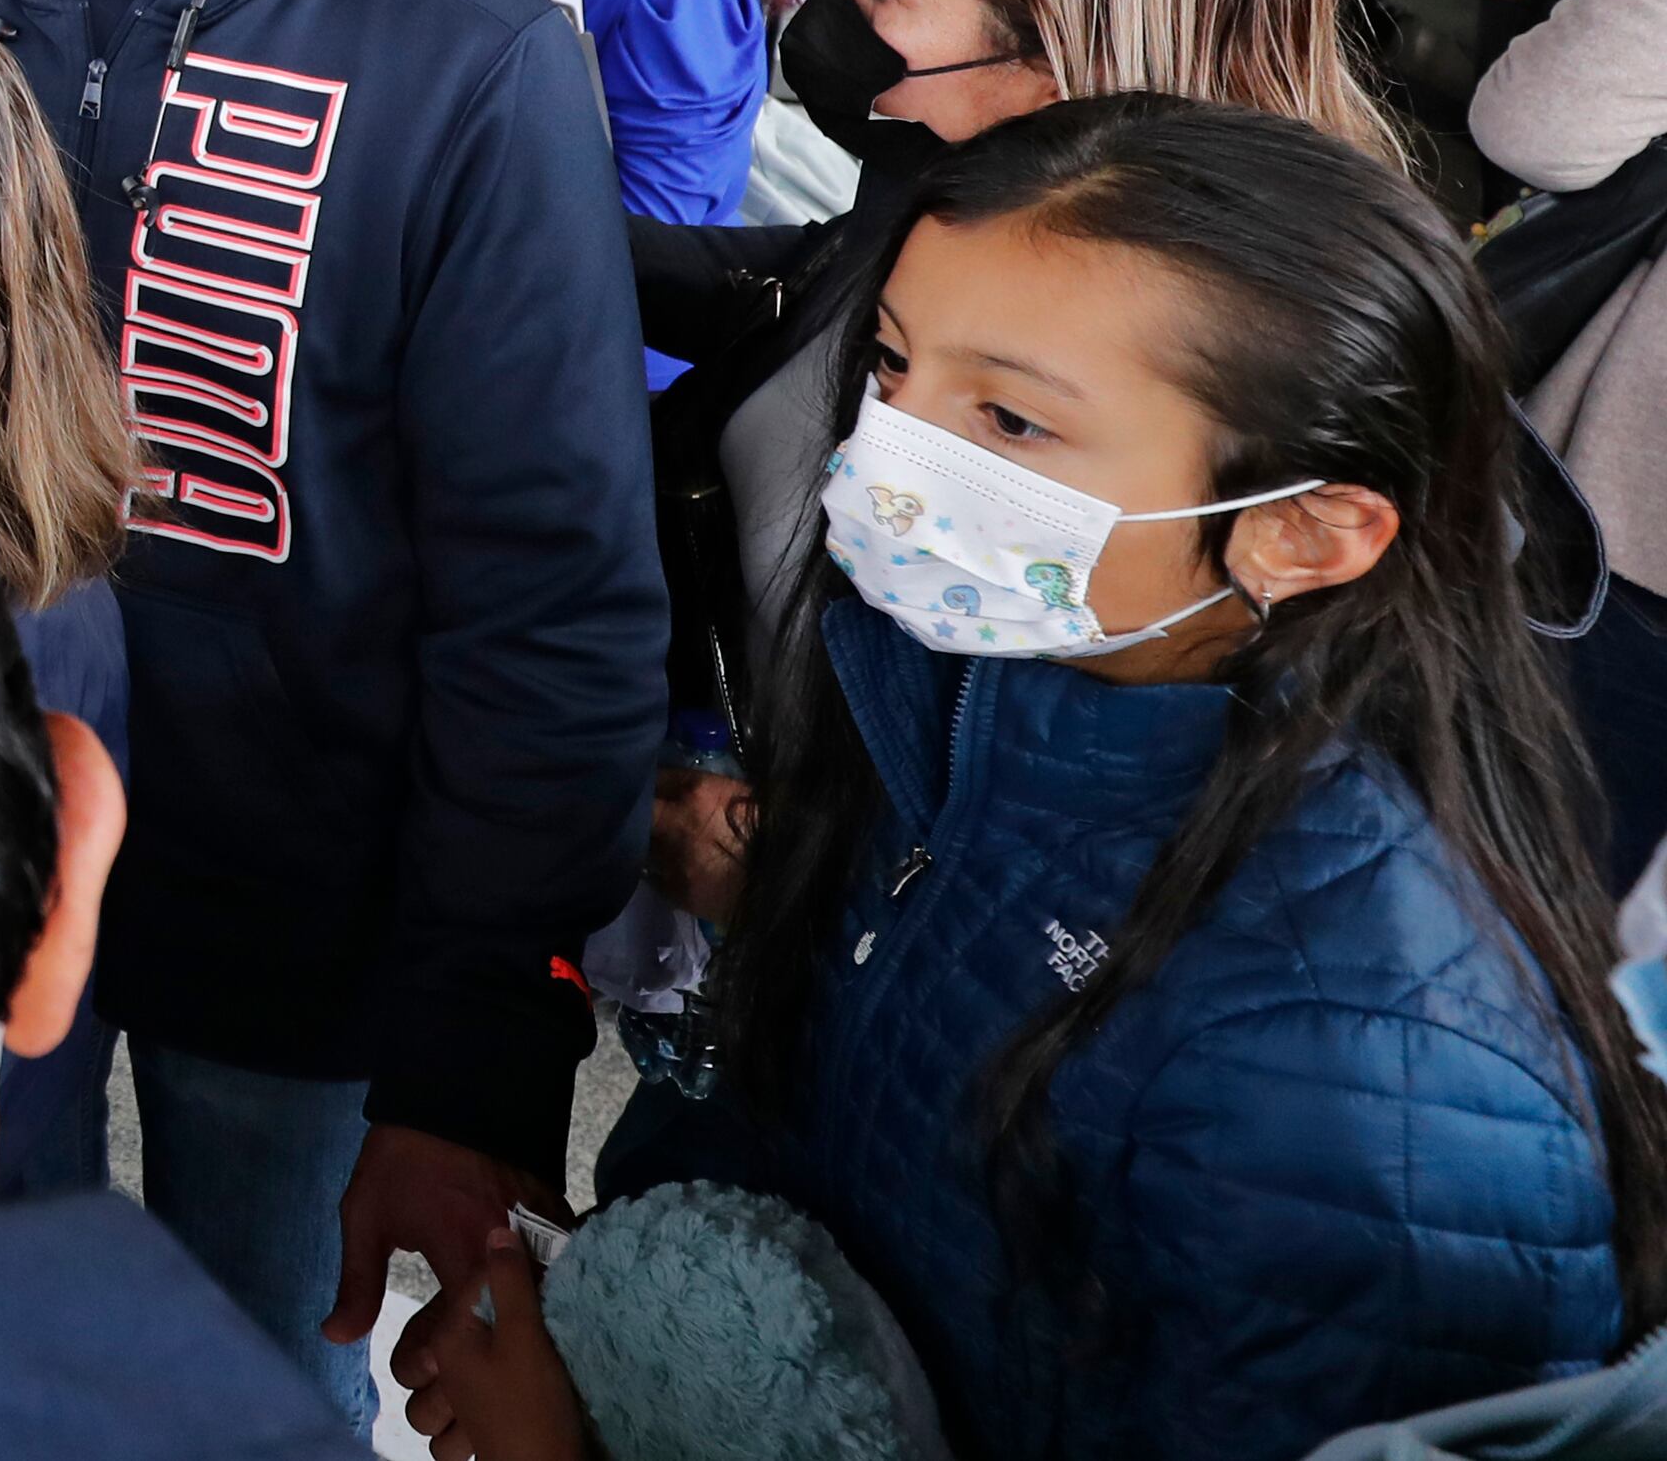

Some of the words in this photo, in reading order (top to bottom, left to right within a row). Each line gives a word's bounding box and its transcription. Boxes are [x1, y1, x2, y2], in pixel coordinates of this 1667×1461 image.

[117, 51, 348, 564] PUMA
[1044, 919, 1099, 977] NORT
[1047, 950, 1086, 992] FAC
